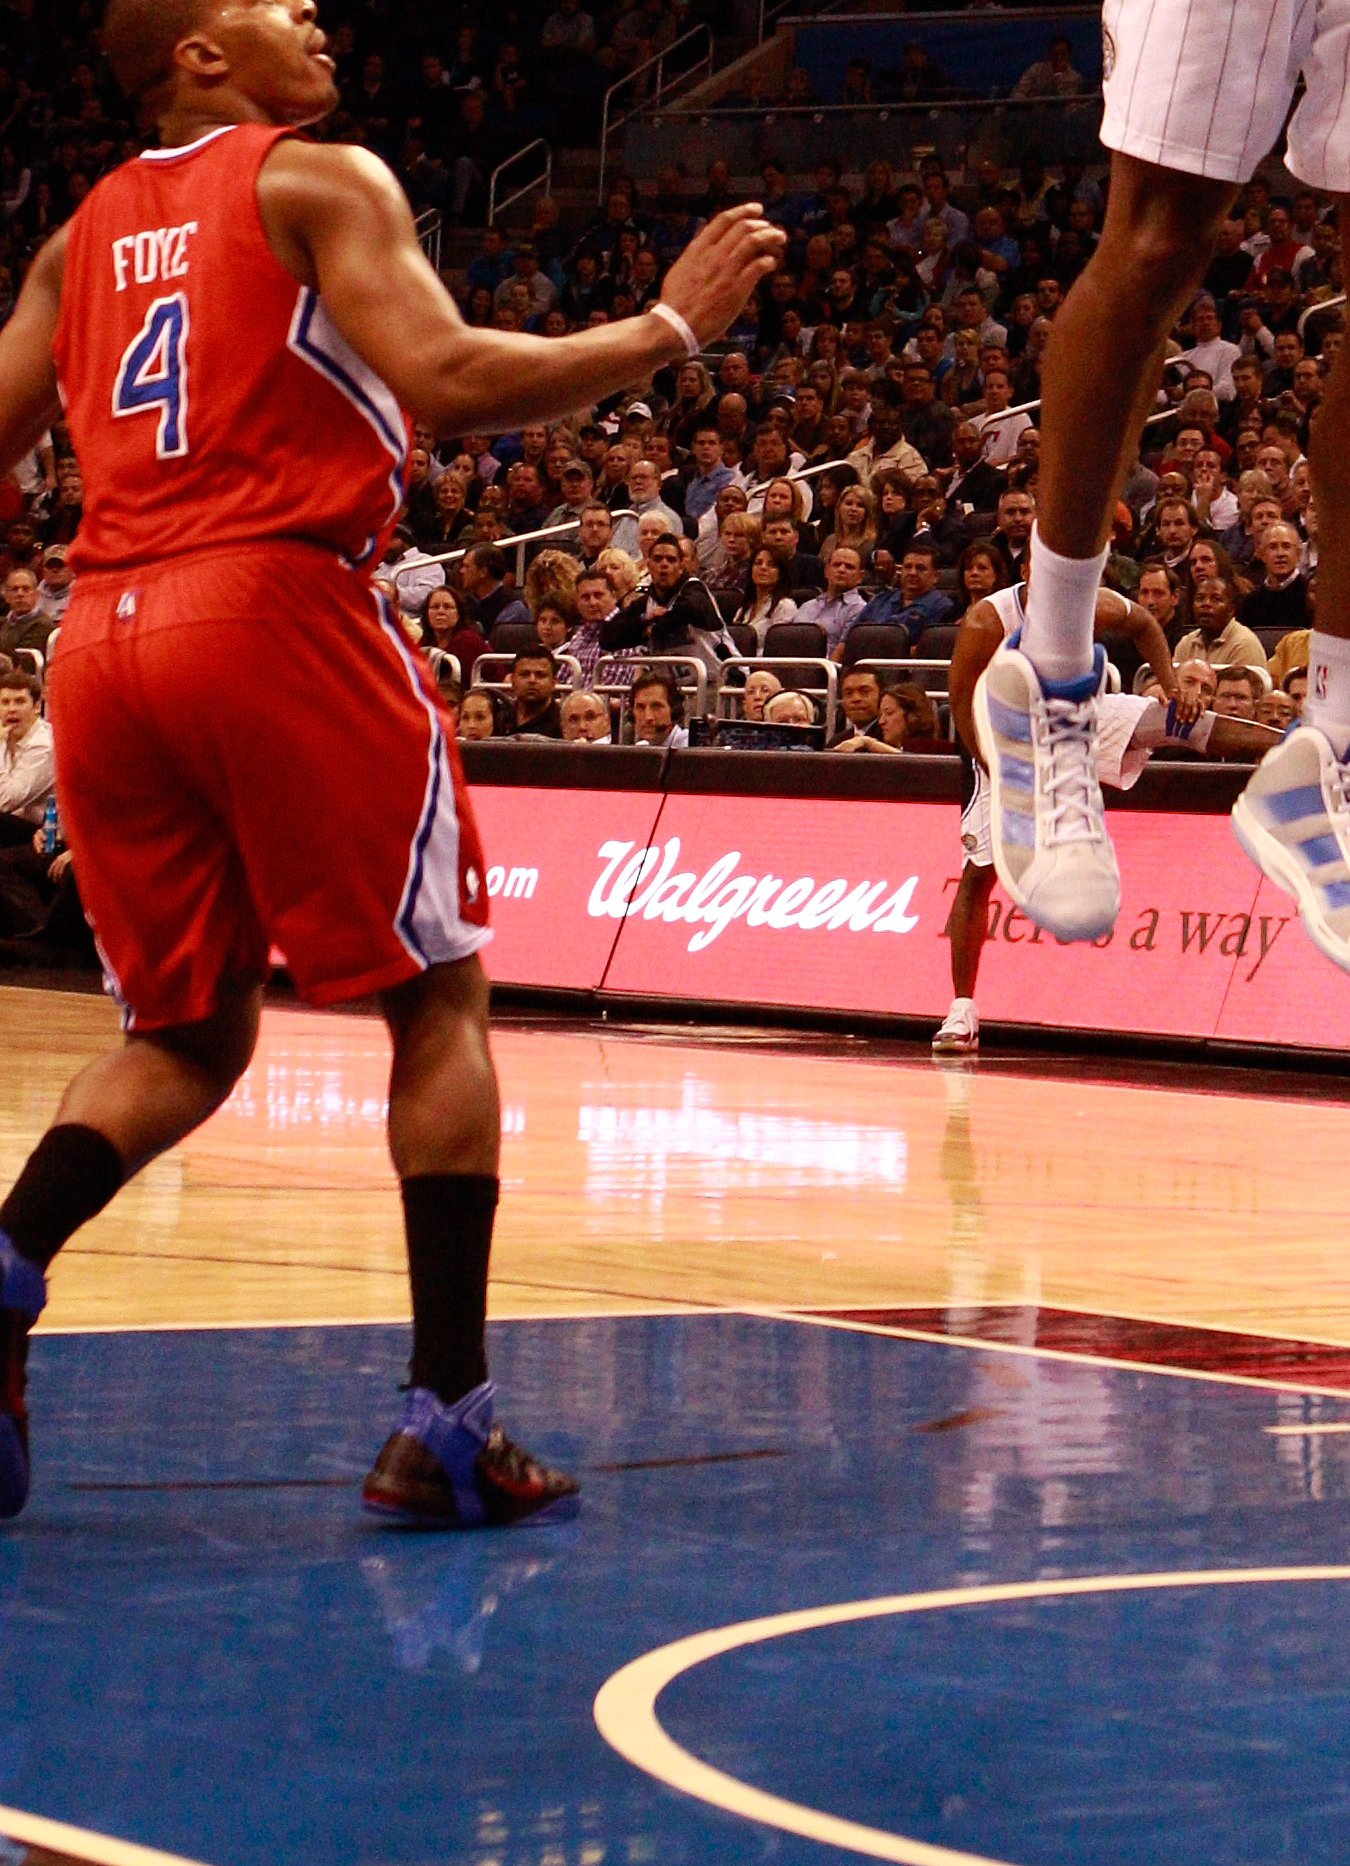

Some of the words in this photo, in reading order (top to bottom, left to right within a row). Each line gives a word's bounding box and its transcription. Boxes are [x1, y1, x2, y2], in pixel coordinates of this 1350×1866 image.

[112, 220, 198, 293] FOYE
[111, 291, 191, 461] 4
[587, 836, 920, 952] Walgreens
[1129, 907, 1160, 951] a
[1180, 910, 1291, 982] way
